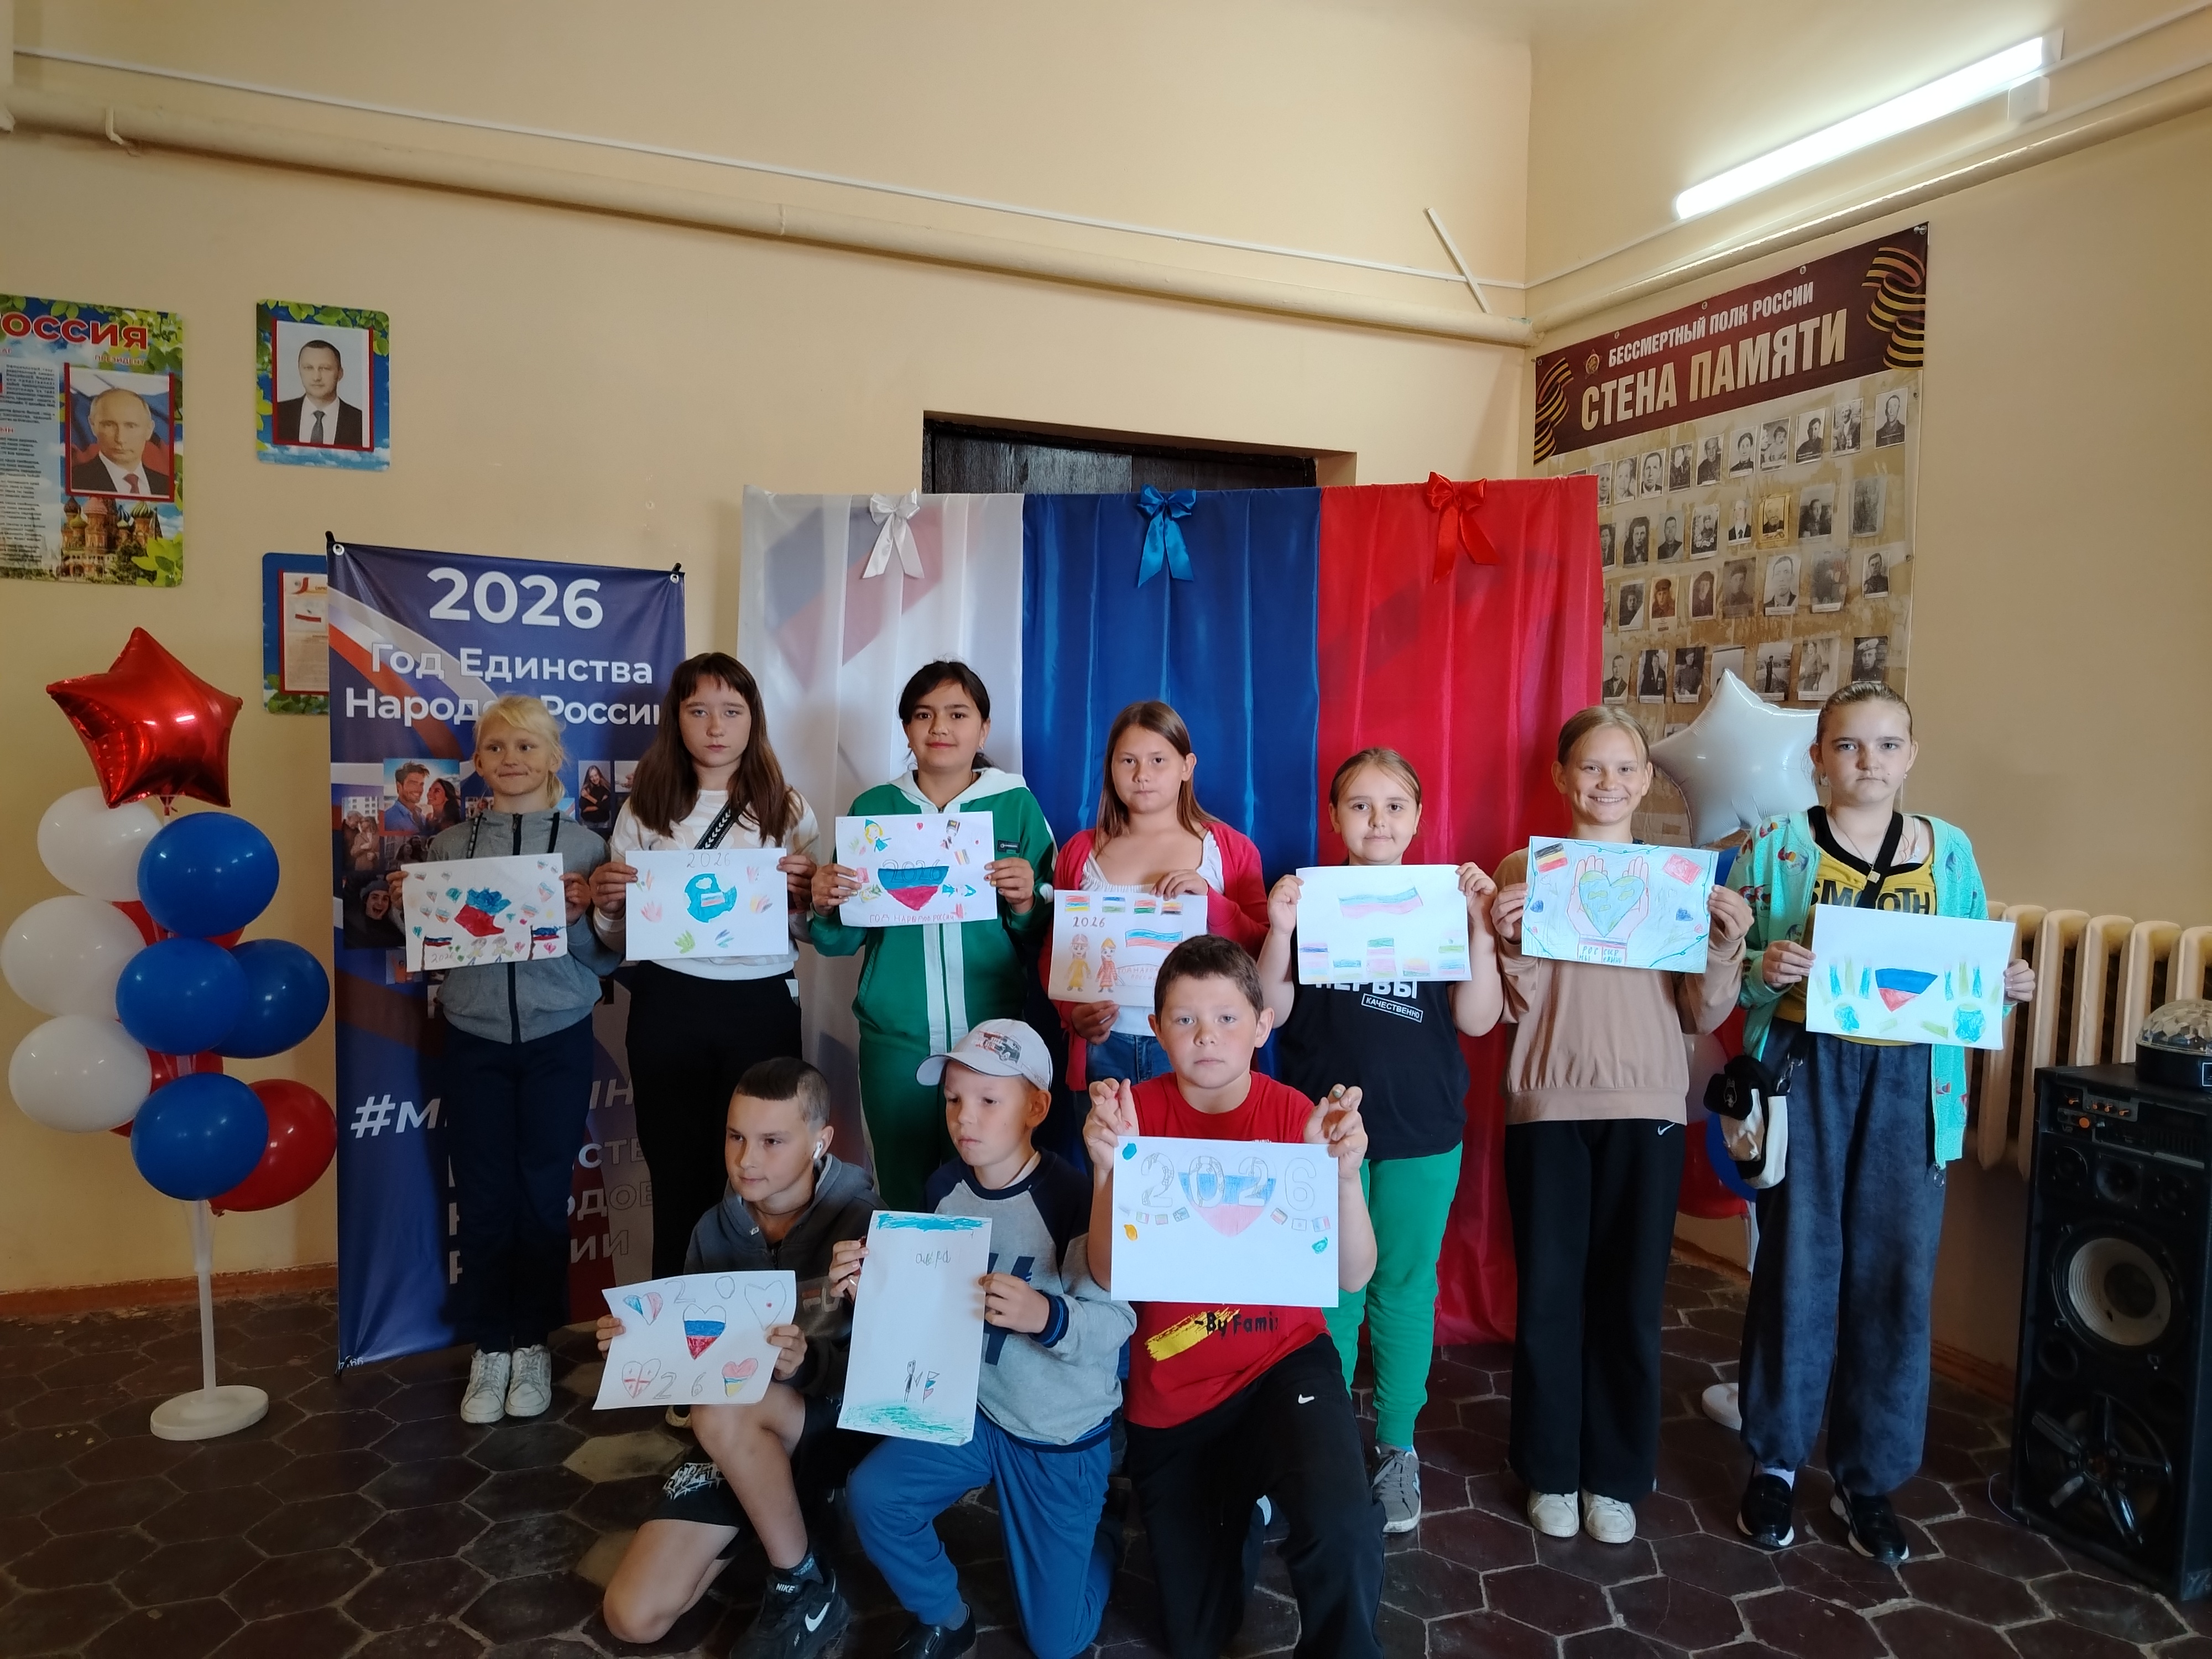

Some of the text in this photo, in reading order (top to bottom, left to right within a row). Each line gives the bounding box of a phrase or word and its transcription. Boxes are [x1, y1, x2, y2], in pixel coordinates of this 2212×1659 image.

[0, 311, 148, 351] ОССИЯ
[1608, 281, 1814, 368] БЕССМЕРТНЫЙ ПОЛК РОССИИ
[1580, 308, 1848, 431] СТЕНА ПАМЯТИ
[426, 567, 603, 629] 2026
[372, 643, 653, 684] Год Единства
[346, 687, 660, 727] Народ Росси
[686, 852, 731, 868] 2026
[883, 859, 943, 883] 2026
[870, 914, 890, 923] ГОД
[1073, 917, 1105, 927] 2026
[431, 951, 453, 963] 2026
[1366, 997, 1420, 1018] КАЧЕСТВЕННО
[1141, 1152, 1317, 1211] 2026
[653, 1371, 707, 1400] 26
[775, 1583, 796, 1594] NIKE
